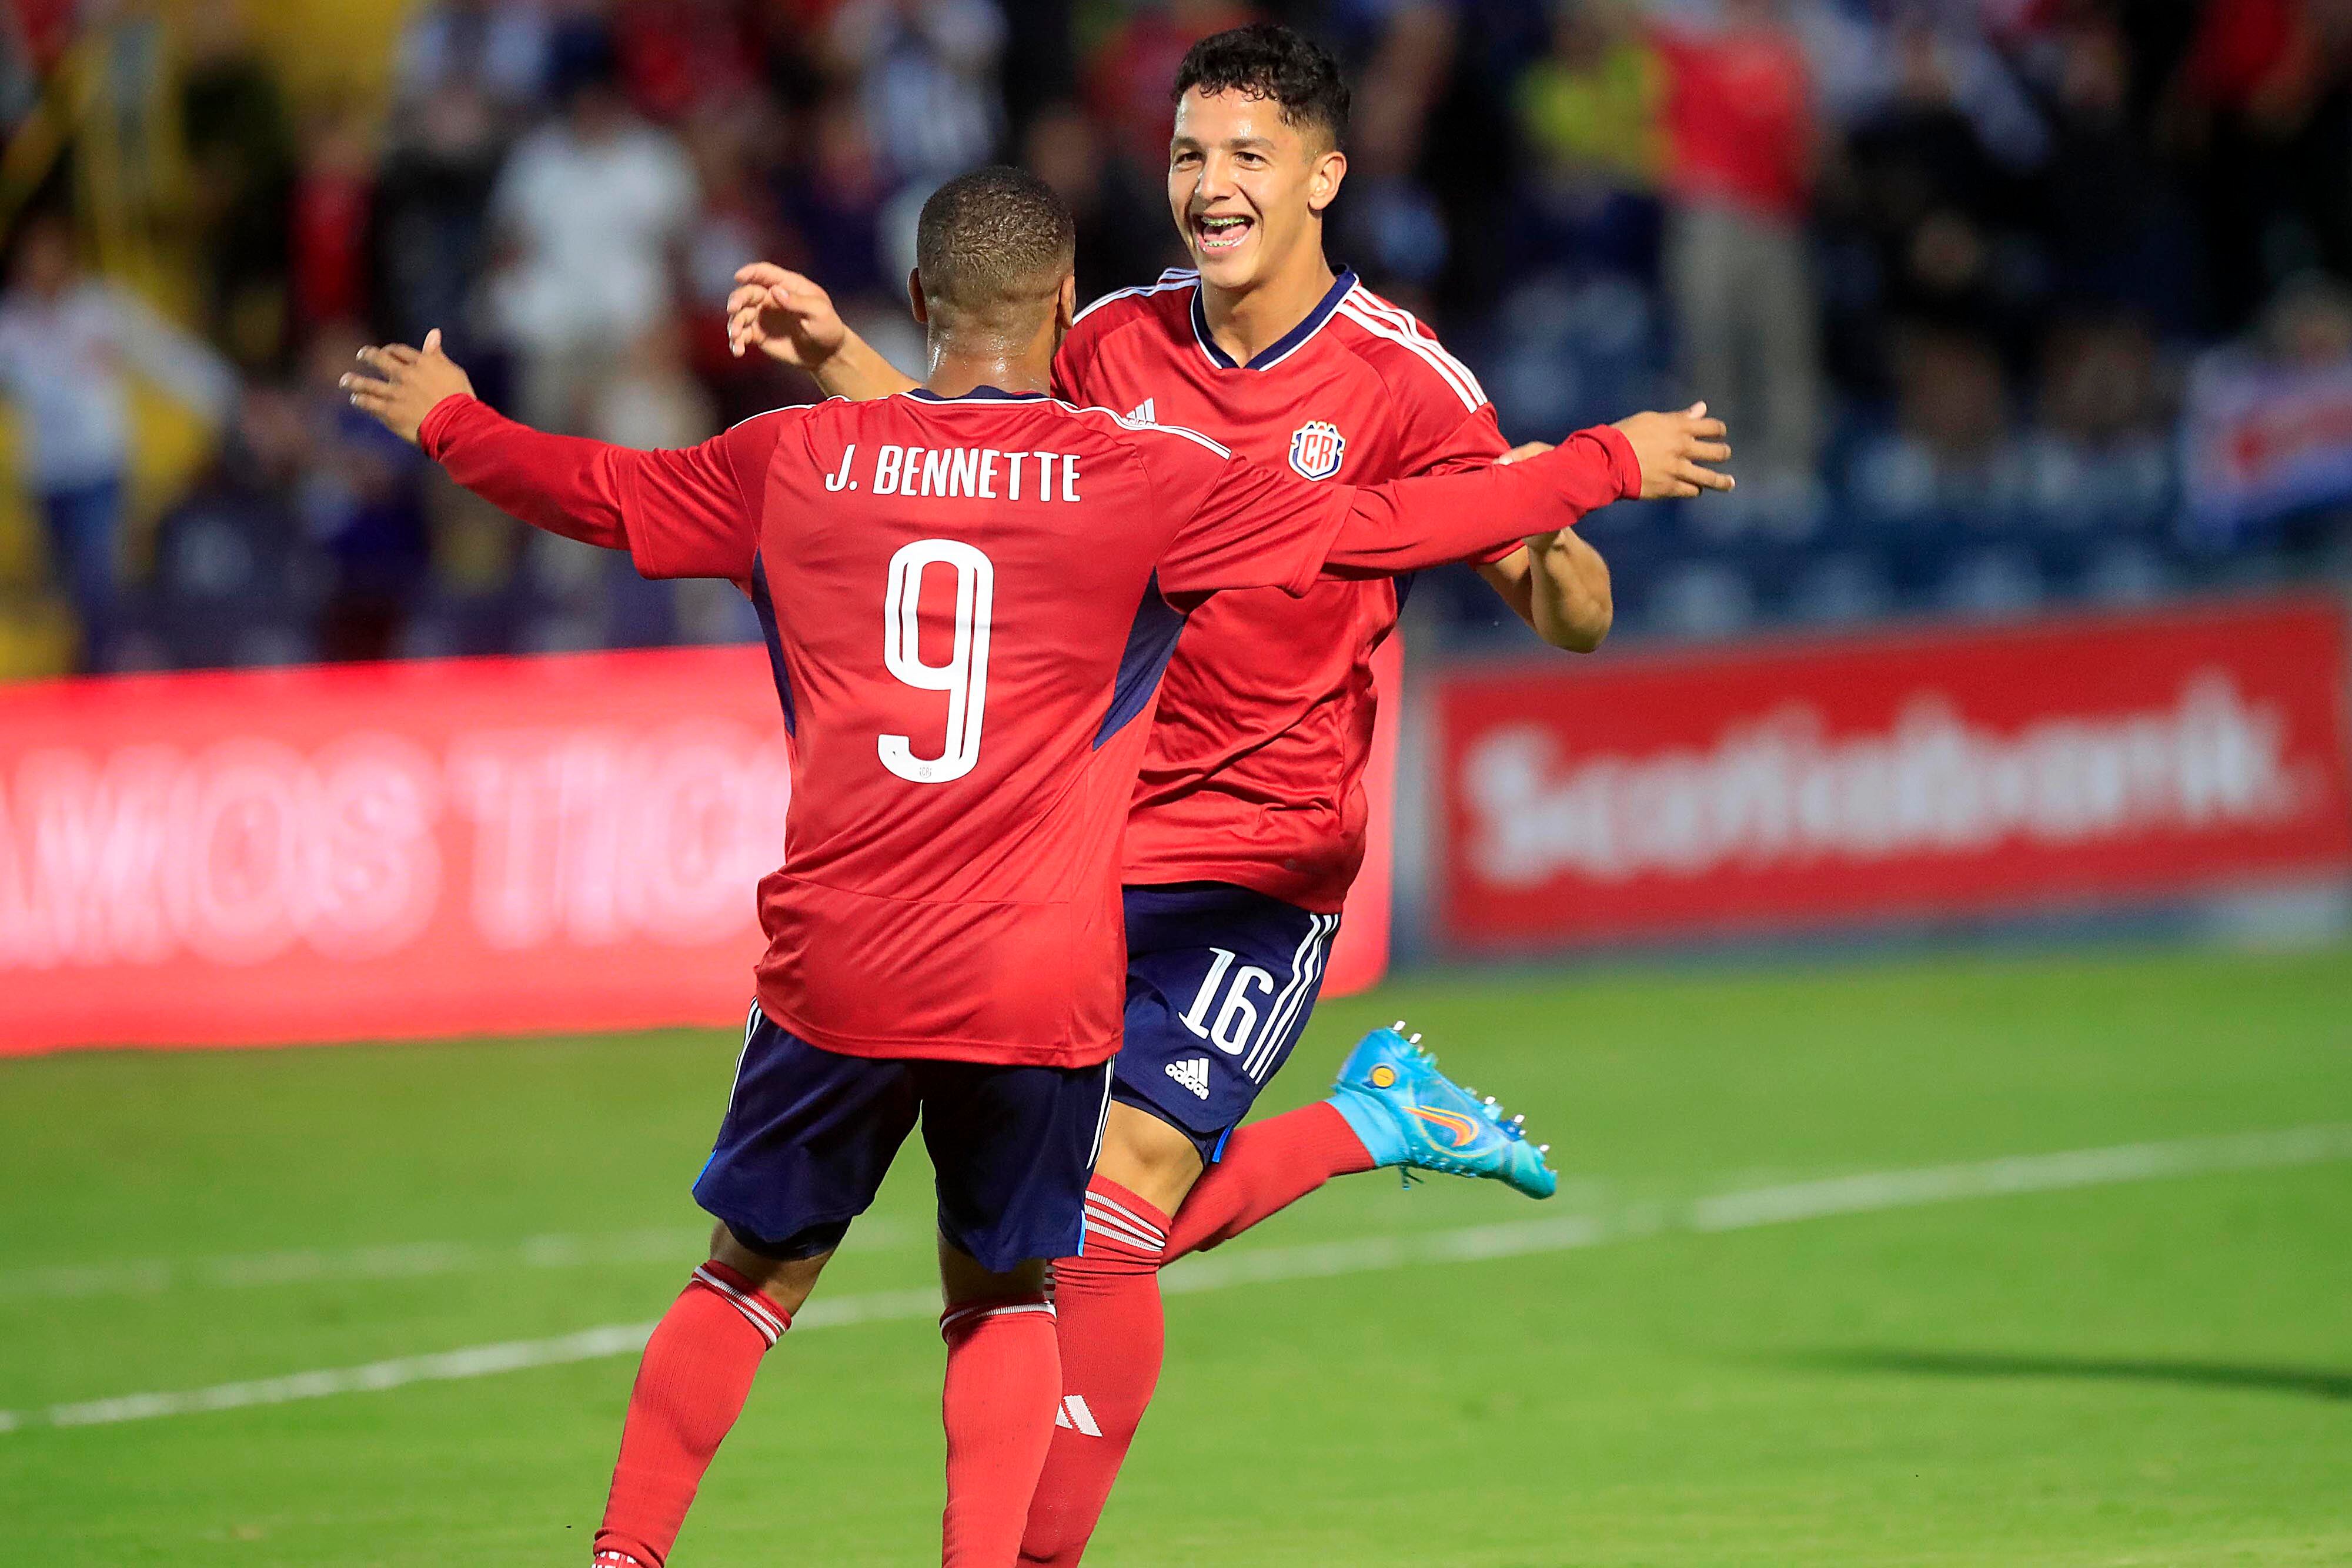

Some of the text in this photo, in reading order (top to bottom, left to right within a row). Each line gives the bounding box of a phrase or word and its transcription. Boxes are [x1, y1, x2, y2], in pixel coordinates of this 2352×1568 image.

[824, 443, 1081, 503] J. BENNETTE
[1302, 434, 1333, 470] CR
[877, 538, 994, 784] 9
[1463, 667, 2289, 888] Scotiabank
[1178, 947, 1275, 1056] 16
[1165, 1063, 1210, 1101] adidas
